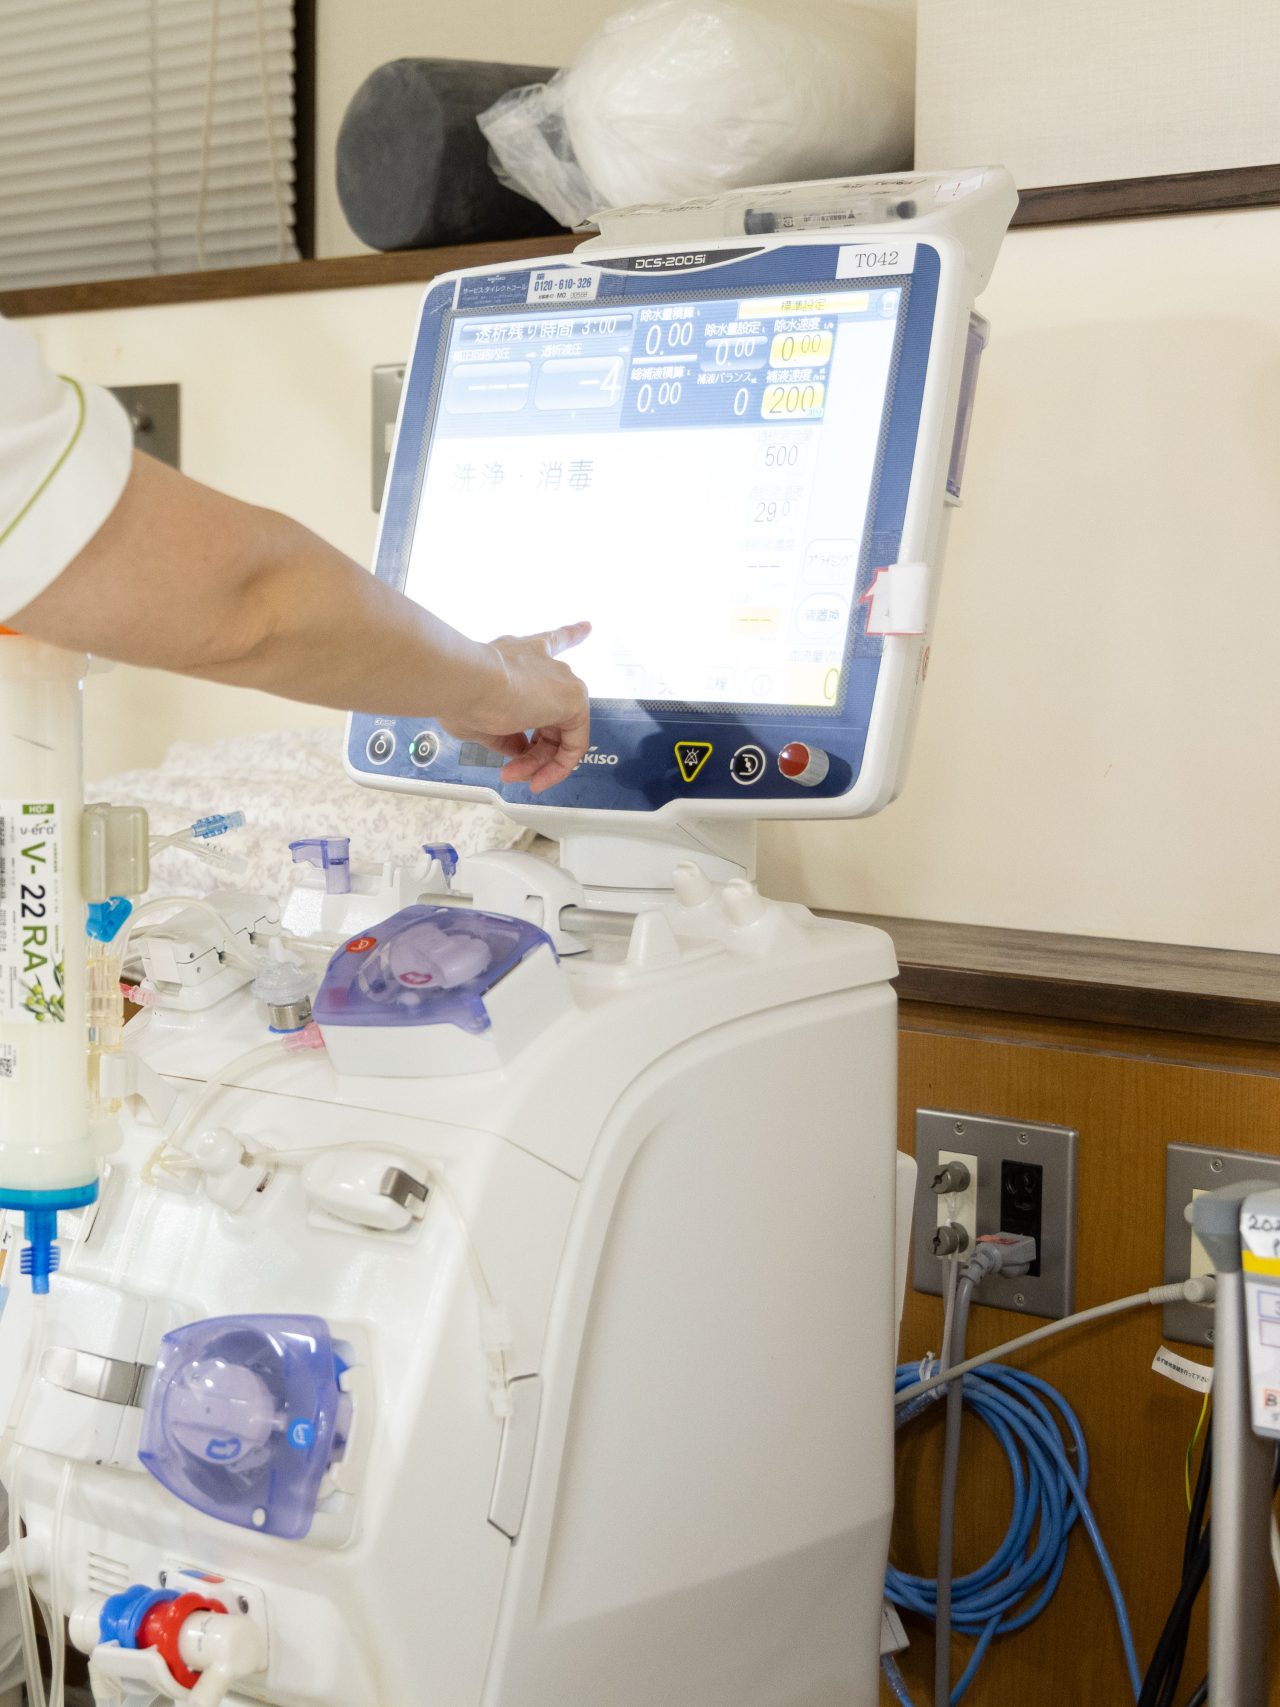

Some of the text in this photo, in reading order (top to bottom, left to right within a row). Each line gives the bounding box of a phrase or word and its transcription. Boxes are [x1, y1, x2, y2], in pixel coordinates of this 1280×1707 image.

[634, 254, 706, 270] DCS-200Si
[854, 250, 899, 269] T042
[534, 277, 592, 292] 0120-610-326
[581, 317, 617, 336] 3:00
[645, 321, 693, 355] 0.00
[637, 381, 682, 413] 0.00
[733, 387, 749, 416] 0
[769, 385, 815, 414] 200
[765, 445, 799, 467] 500
